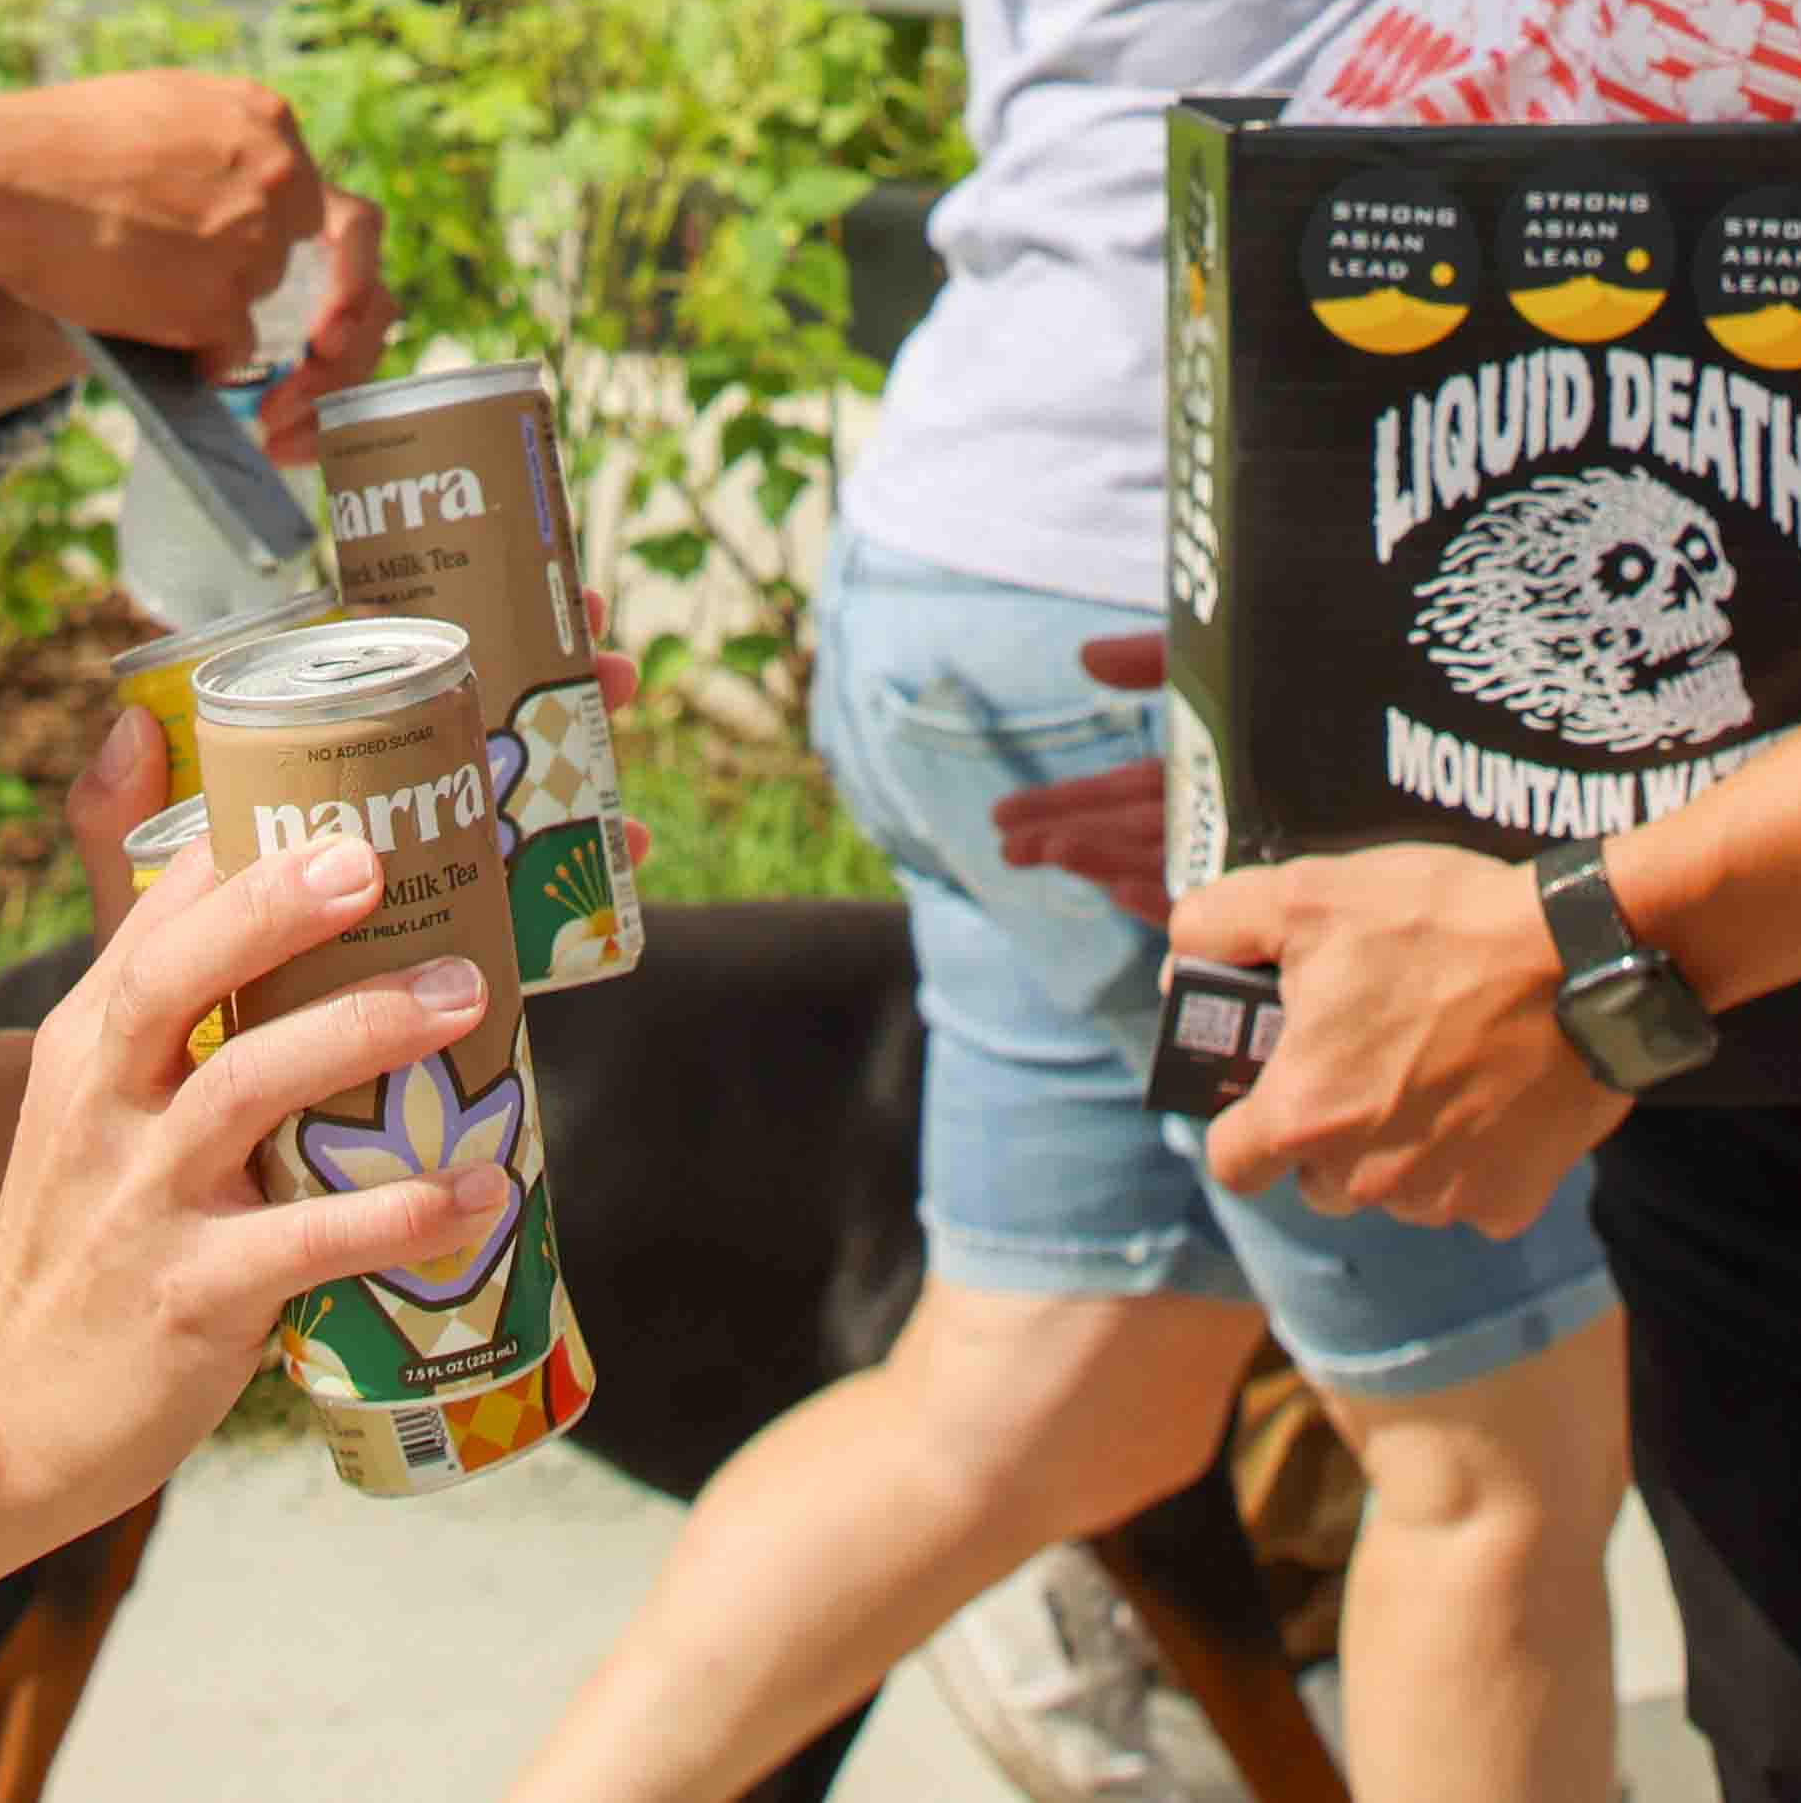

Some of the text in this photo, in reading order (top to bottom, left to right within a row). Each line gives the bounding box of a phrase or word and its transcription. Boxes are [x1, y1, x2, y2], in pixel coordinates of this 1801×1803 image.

[1330, 200, 1458, 229] STRONG
[1524, 189, 1651, 215] STRONG
[1328, 229, 1425, 254] ASIAN
[1523, 218, 1620, 241] ASIAN
[1327, 257, 1410, 281] LEAD
[1523, 247, 1604, 269] LEAD
[1720, 272, 1801, 297] LEAD
[1373, 346, 1595, 565] LIQUID
[307, 725, 435, 764] NO ADDED SUGAR
[1385, 705, 1636, 841] MOUNTAIN
[379, 860, 479, 910] Milk Tea
[340, 907, 454, 944] OAT MILK LATTE
[444, 1359, 466, 1375] OZ
